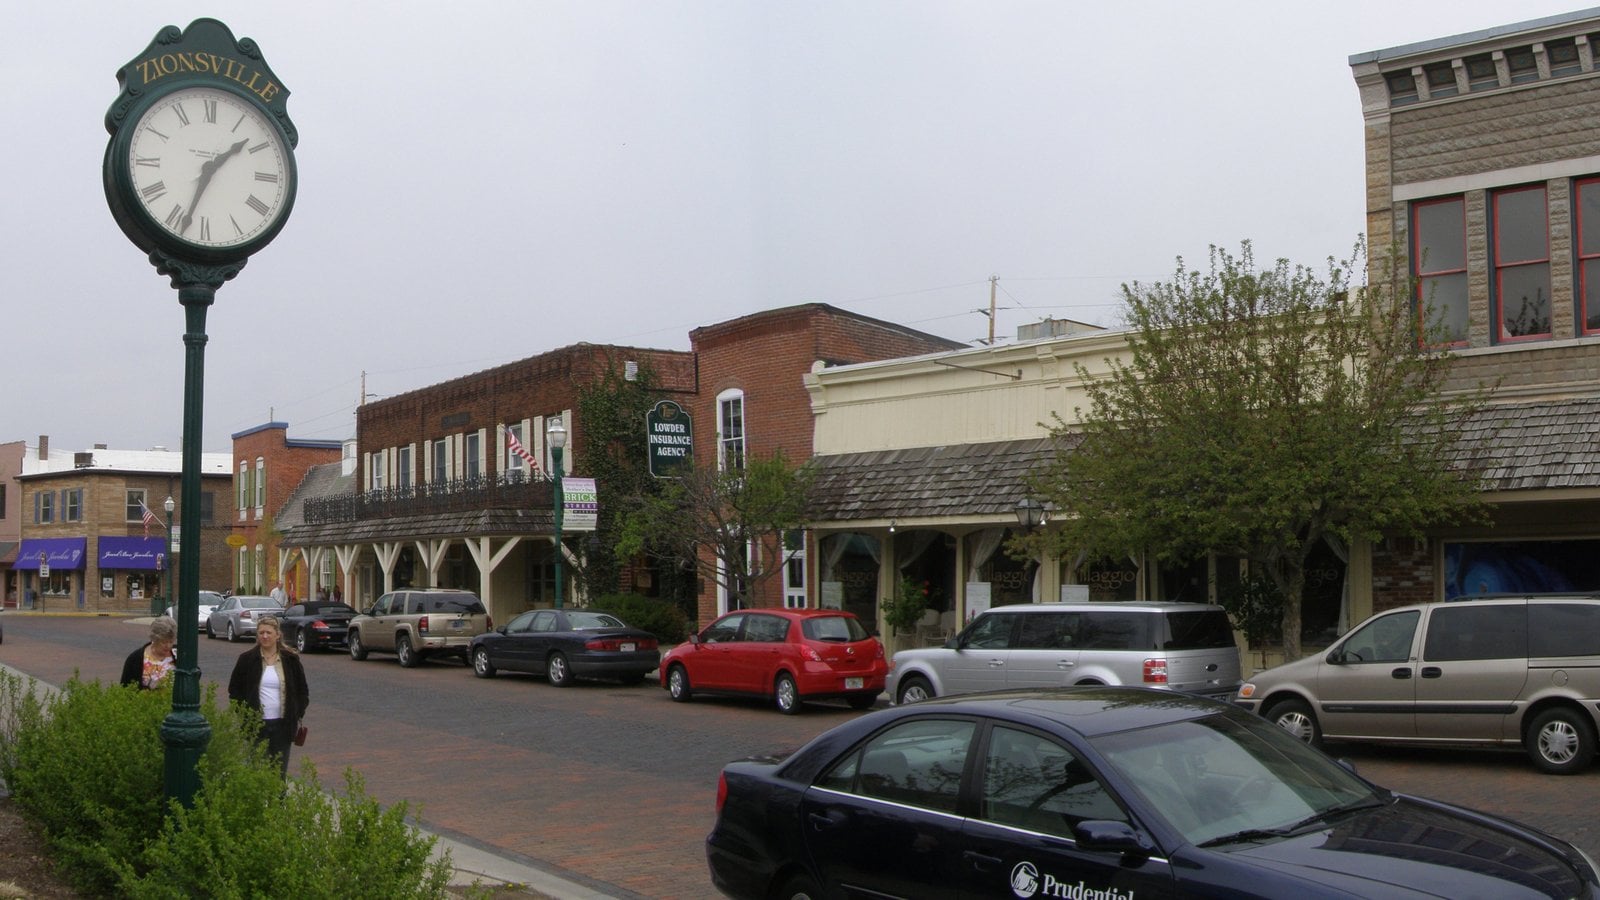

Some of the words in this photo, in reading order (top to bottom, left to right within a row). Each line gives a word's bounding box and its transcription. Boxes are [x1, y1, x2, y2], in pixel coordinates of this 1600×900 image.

[136, 52, 279, 102] ZIONSVILLE
[654, 422, 686, 433] LOWDER
[650, 434, 692, 445] INSURANCE
[656, 446, 686, 457] AGENCY
[564, 493, 597, 502] BRICK
[1079, 565, 1136, 589] illaggio
